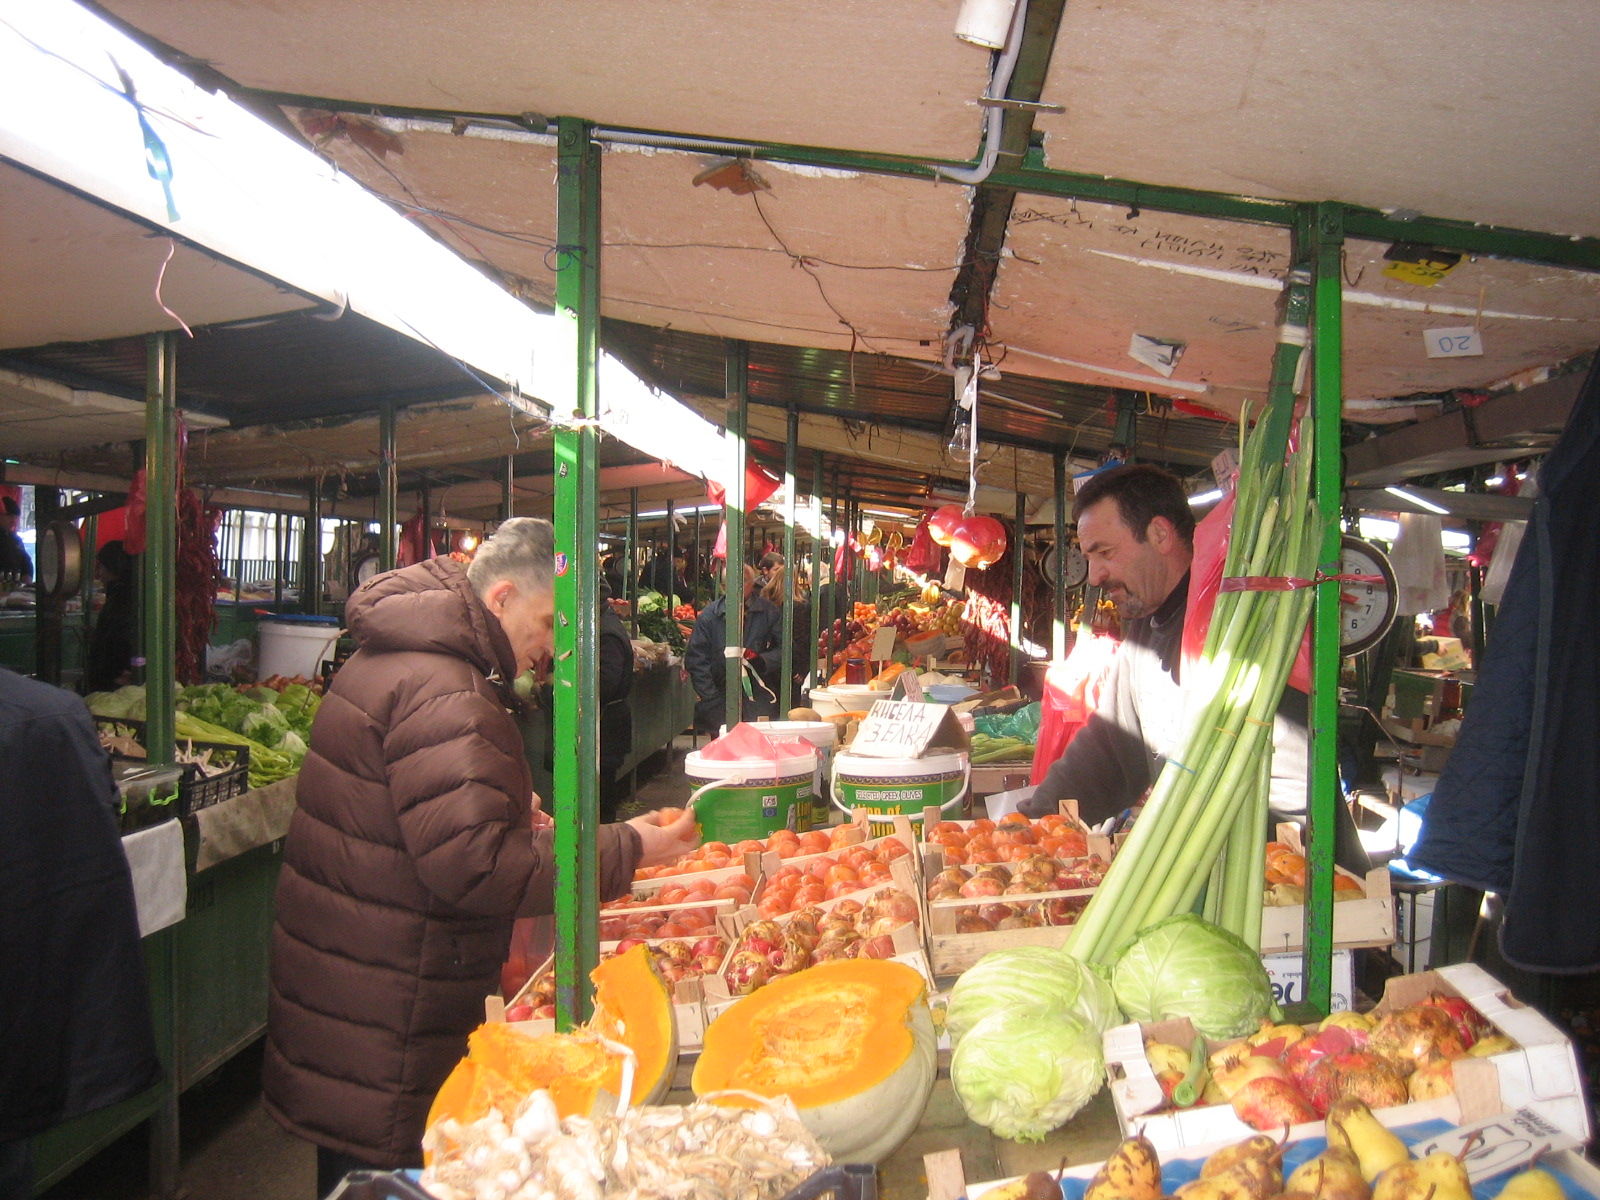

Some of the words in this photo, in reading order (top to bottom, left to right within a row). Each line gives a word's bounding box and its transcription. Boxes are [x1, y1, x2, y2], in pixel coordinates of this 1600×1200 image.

[1438, 335, 1471, 353] 20
[1366, 605, 1372, 615] 7
[1351, 619, 1358, 629] 6
